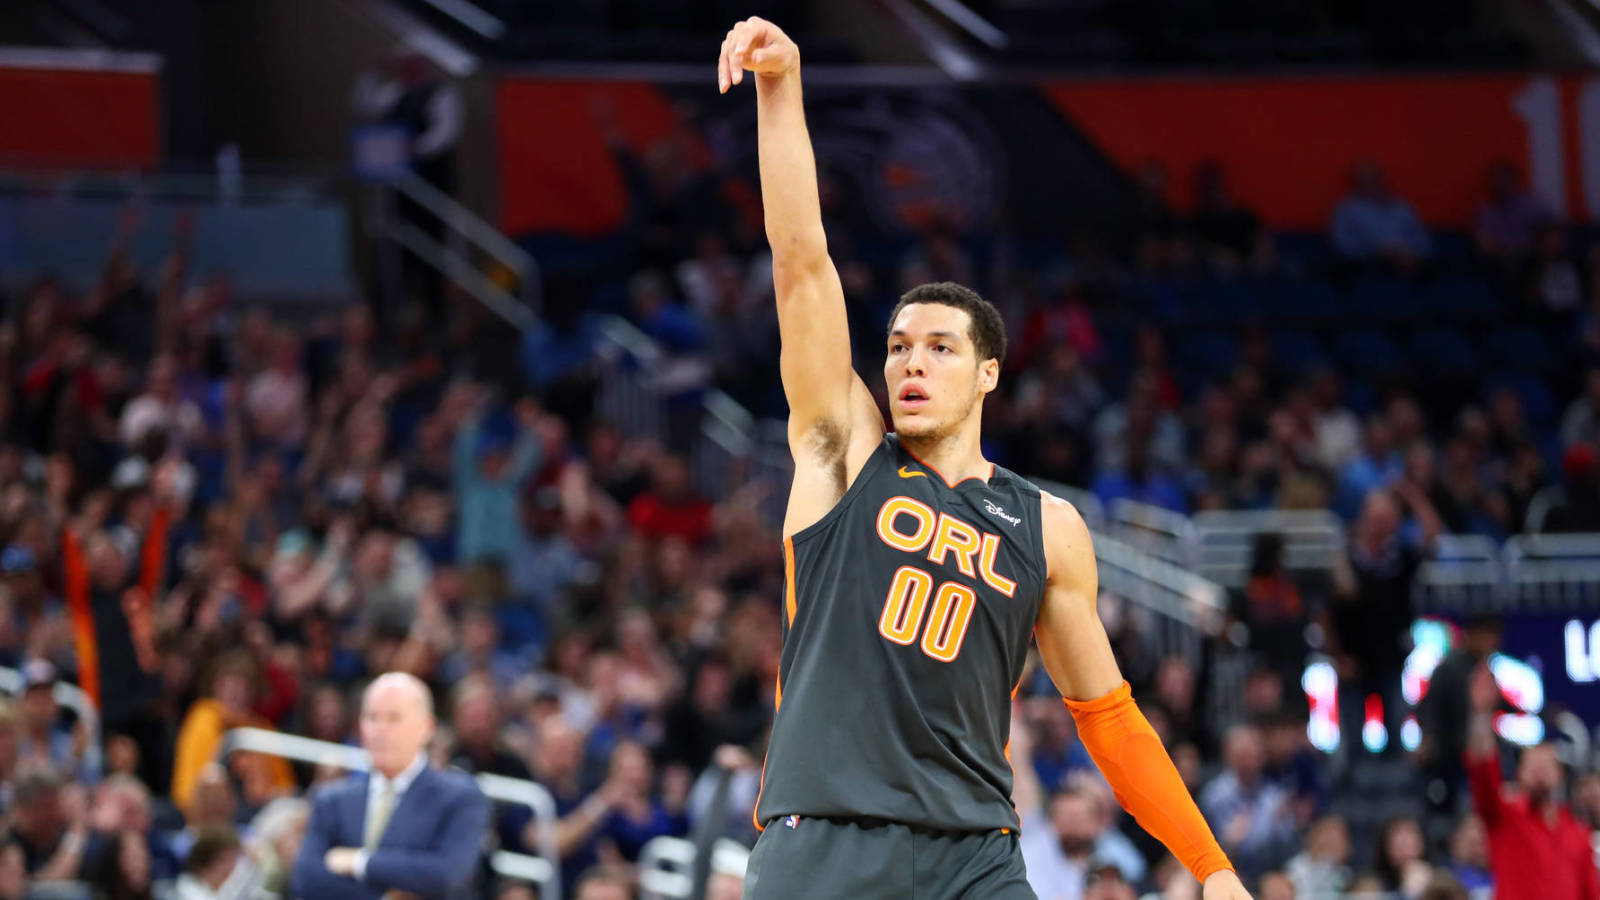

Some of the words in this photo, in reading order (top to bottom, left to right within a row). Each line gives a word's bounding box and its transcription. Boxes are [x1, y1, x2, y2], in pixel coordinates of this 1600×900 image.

[876, 495, 1017, 599] ORL
[983, 499, 1022, 527] Disney
[878, 565, 976, 663] 00
